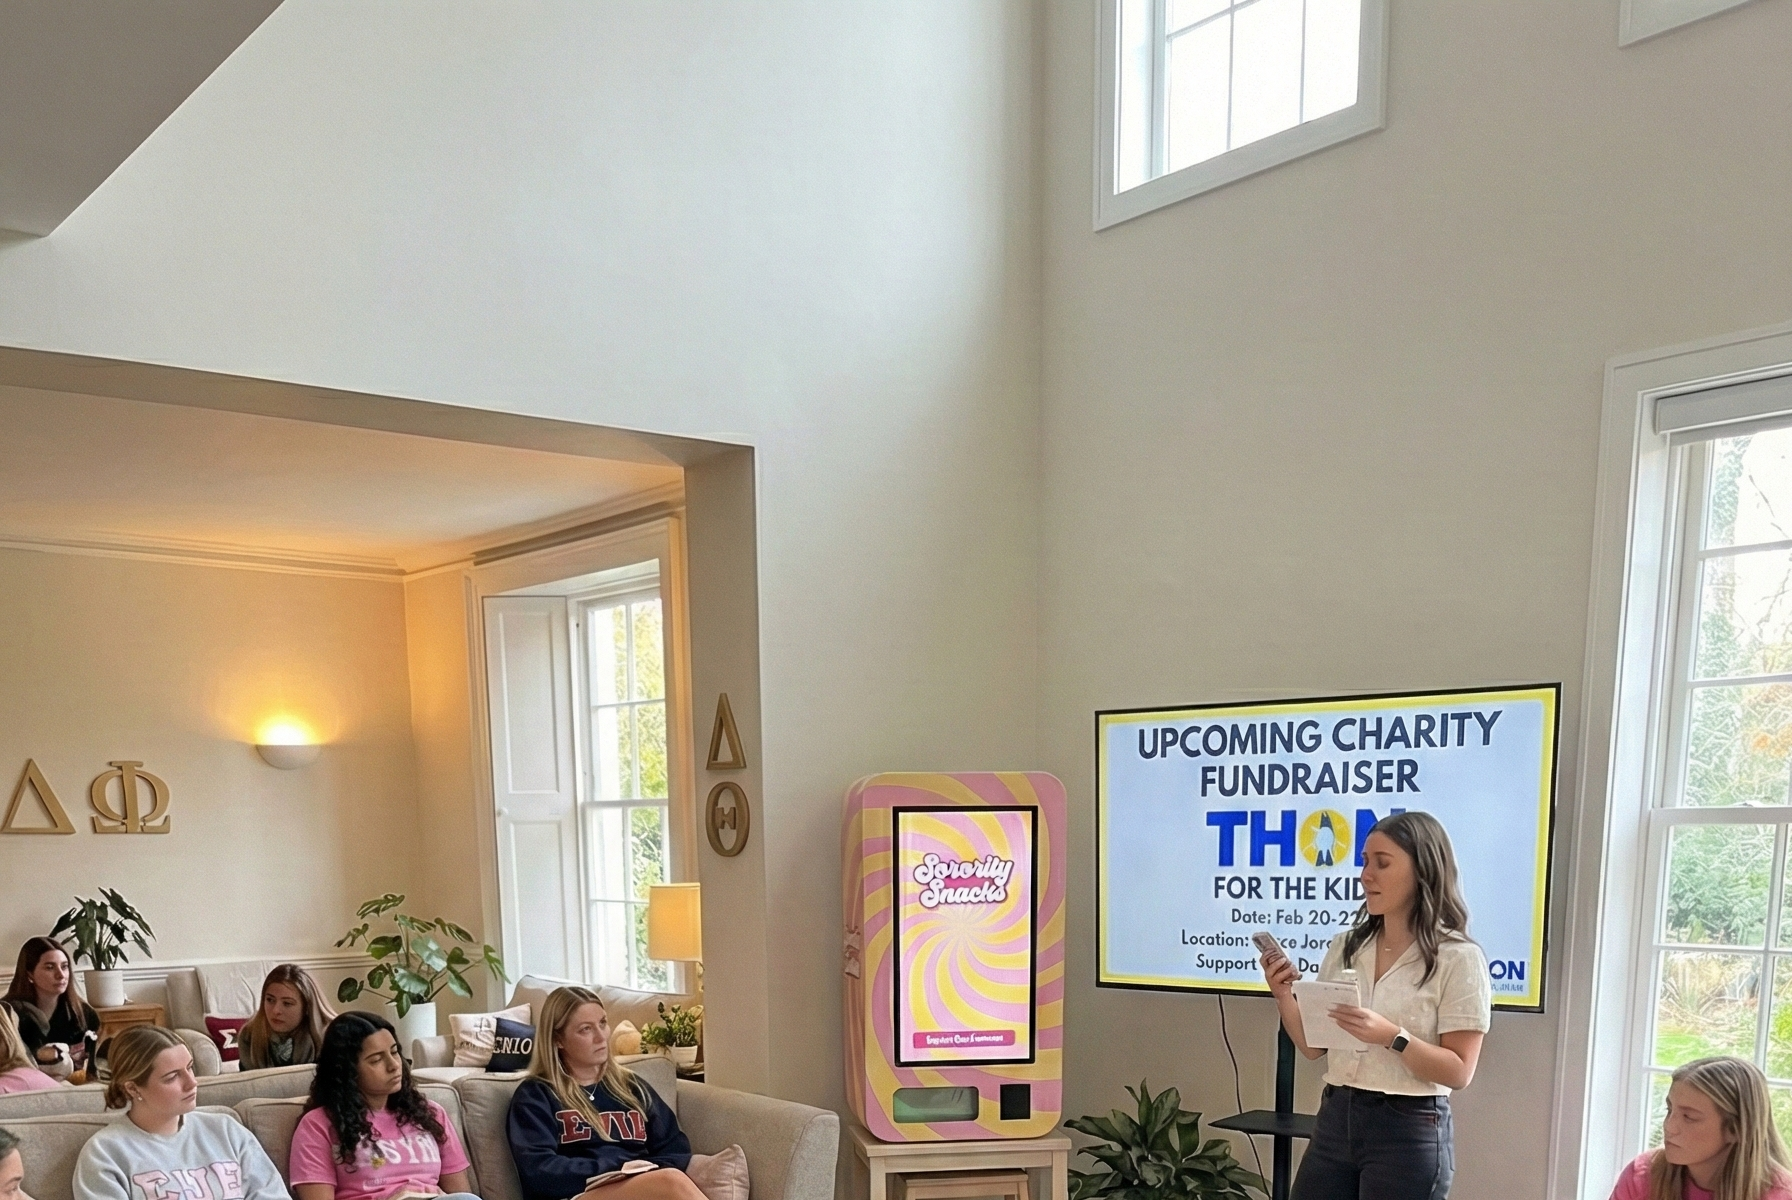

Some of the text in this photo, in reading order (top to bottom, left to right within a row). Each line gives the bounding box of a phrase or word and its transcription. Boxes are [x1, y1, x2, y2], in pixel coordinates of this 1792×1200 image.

[1137, 709, 1503, 760] UPCOMING CHARITY
[1200, 758, 1421, 797] FUNDRAISER
[913, 852, 1014, 886] Sorority
[919, 878, 1007, 908] Snacks
[1213, 875, 1263, 899] FOR
[1269, 876, 1317, 900] THE
[1276, 909, 1303, 925] Feb
[1181, 928, 1249, 947] Location:
[1196, 953, 1258, 974] Support
